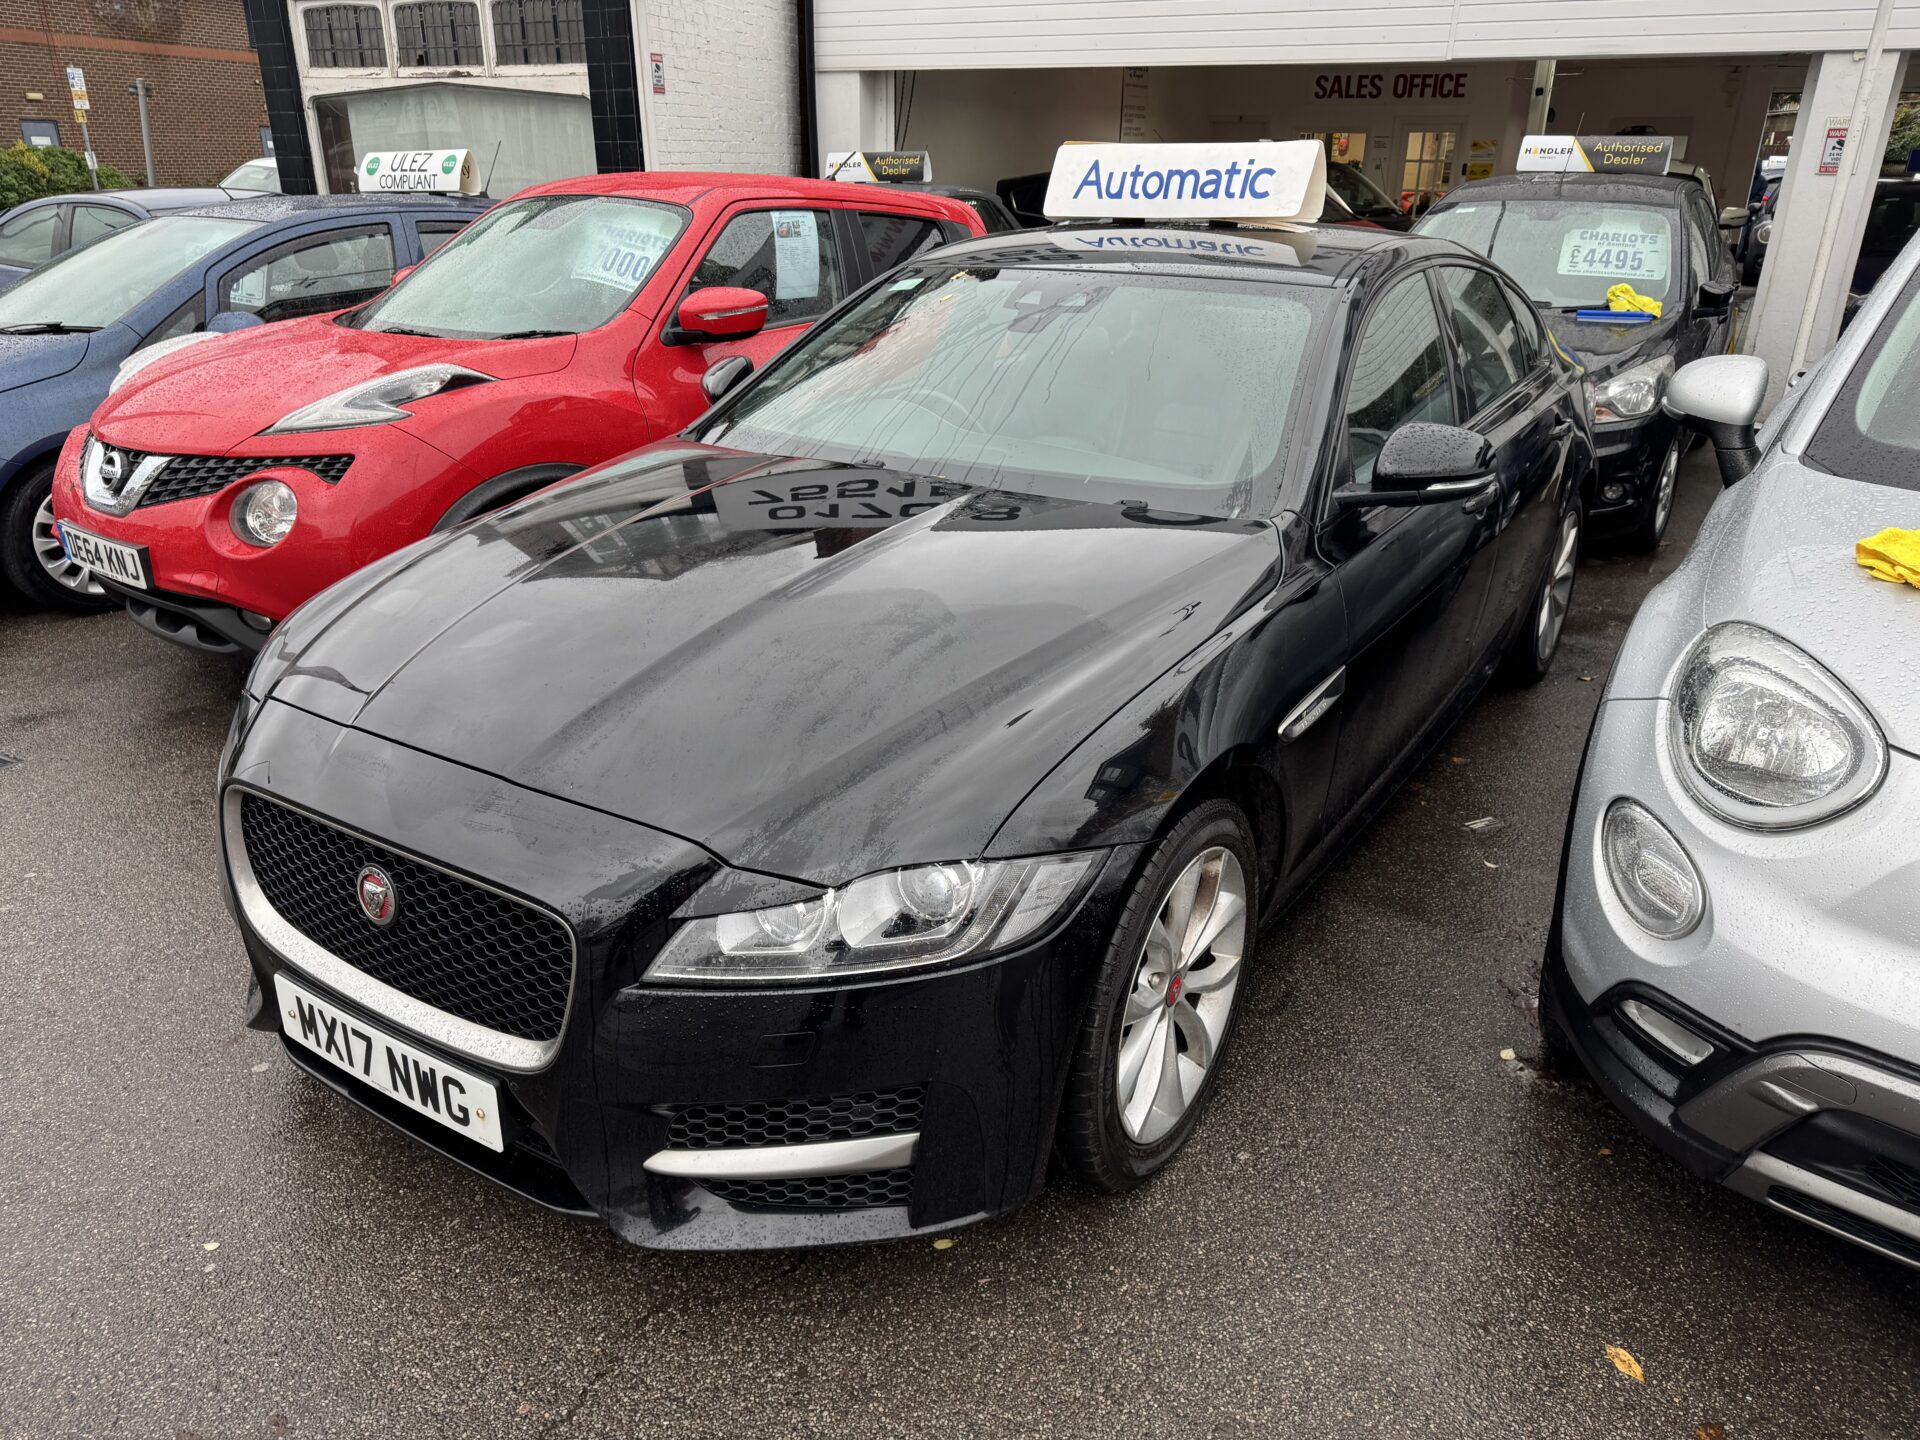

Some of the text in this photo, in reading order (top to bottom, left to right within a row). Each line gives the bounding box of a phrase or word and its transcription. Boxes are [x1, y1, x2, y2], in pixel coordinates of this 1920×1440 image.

[1314, 73, 1468, 99] SALES OFFICE
[1525, 147, 1573, 155] HANDLER
[1594, 142, 1664, 153] Authorised
[391, 153, 433, 172] ULEZ
[875, 155, 920, 165] Authorised
[1603, 153, 1647, 165] Dealer
[882, 166, 911, 175] Dealer
[380, 174, 438, 190] COMPLIANT
[1072, 158, 1277, 200] Automatic
[1580, 230, 1659, 245] CHARIOTS
[1569, 247, 1645, 271] £4495
[65, 530, 104, 570] DE64
[103, 544, 140, 581] KNJ
[295, 995, 471, 1127] MX17 NWG
